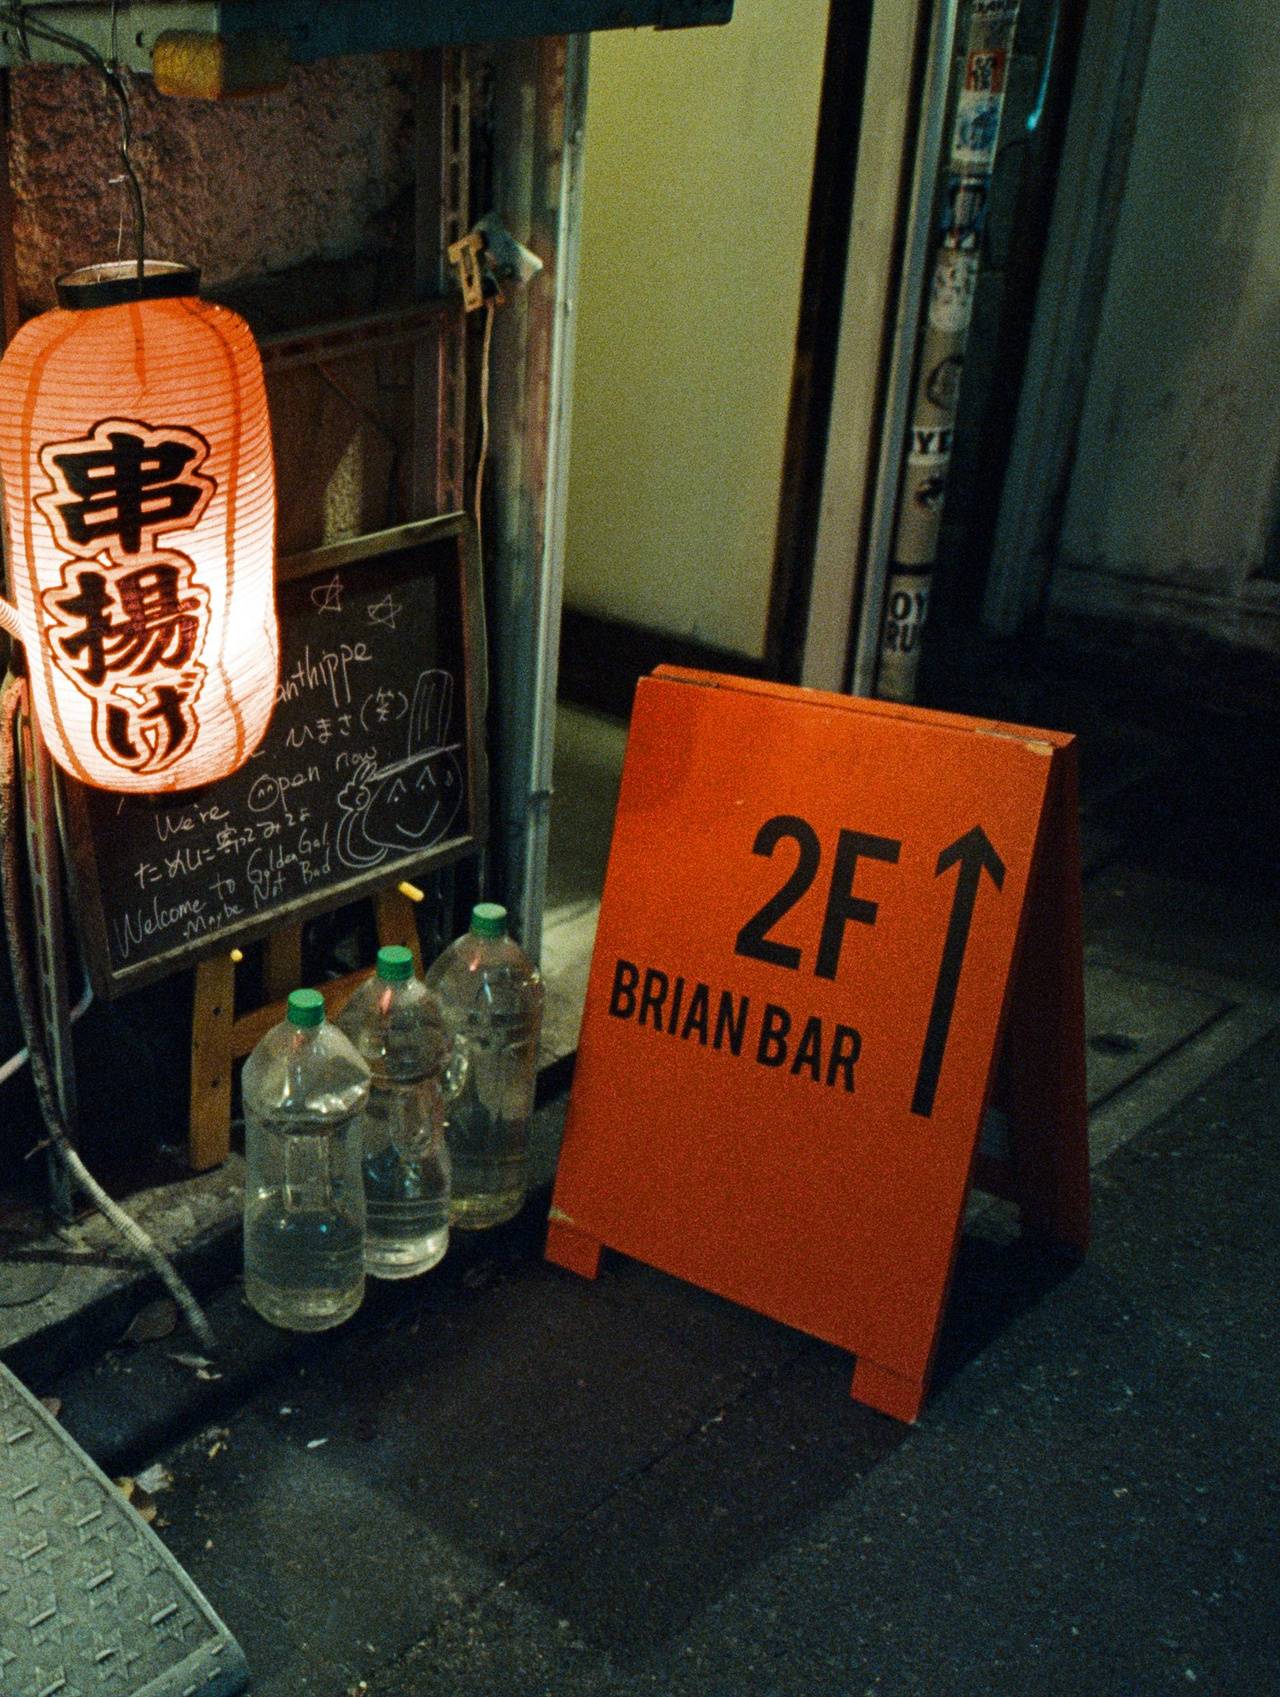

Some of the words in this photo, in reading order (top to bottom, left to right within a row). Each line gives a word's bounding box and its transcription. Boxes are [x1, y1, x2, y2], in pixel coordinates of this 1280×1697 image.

[49, 429, 205, 763] 串揚げ
[273, 641, 373, 709] anthippe
[154, 802, 231, 842] We're
[247, 765, 321, 812] Open
[334, 745, 378, 772] now
[112, 895, 207, 959] Welcome
[208, 872, 237, 900] to
[246, 844, 298, 885] Golden
[252, 870, 287, 909] Not
[298, 845, 331, 886] Bad
[733, 814, 902, 982] 2F
[607, 959, 751, 1058] BRIAN
[755, 1004, 864, 1093] BAR
